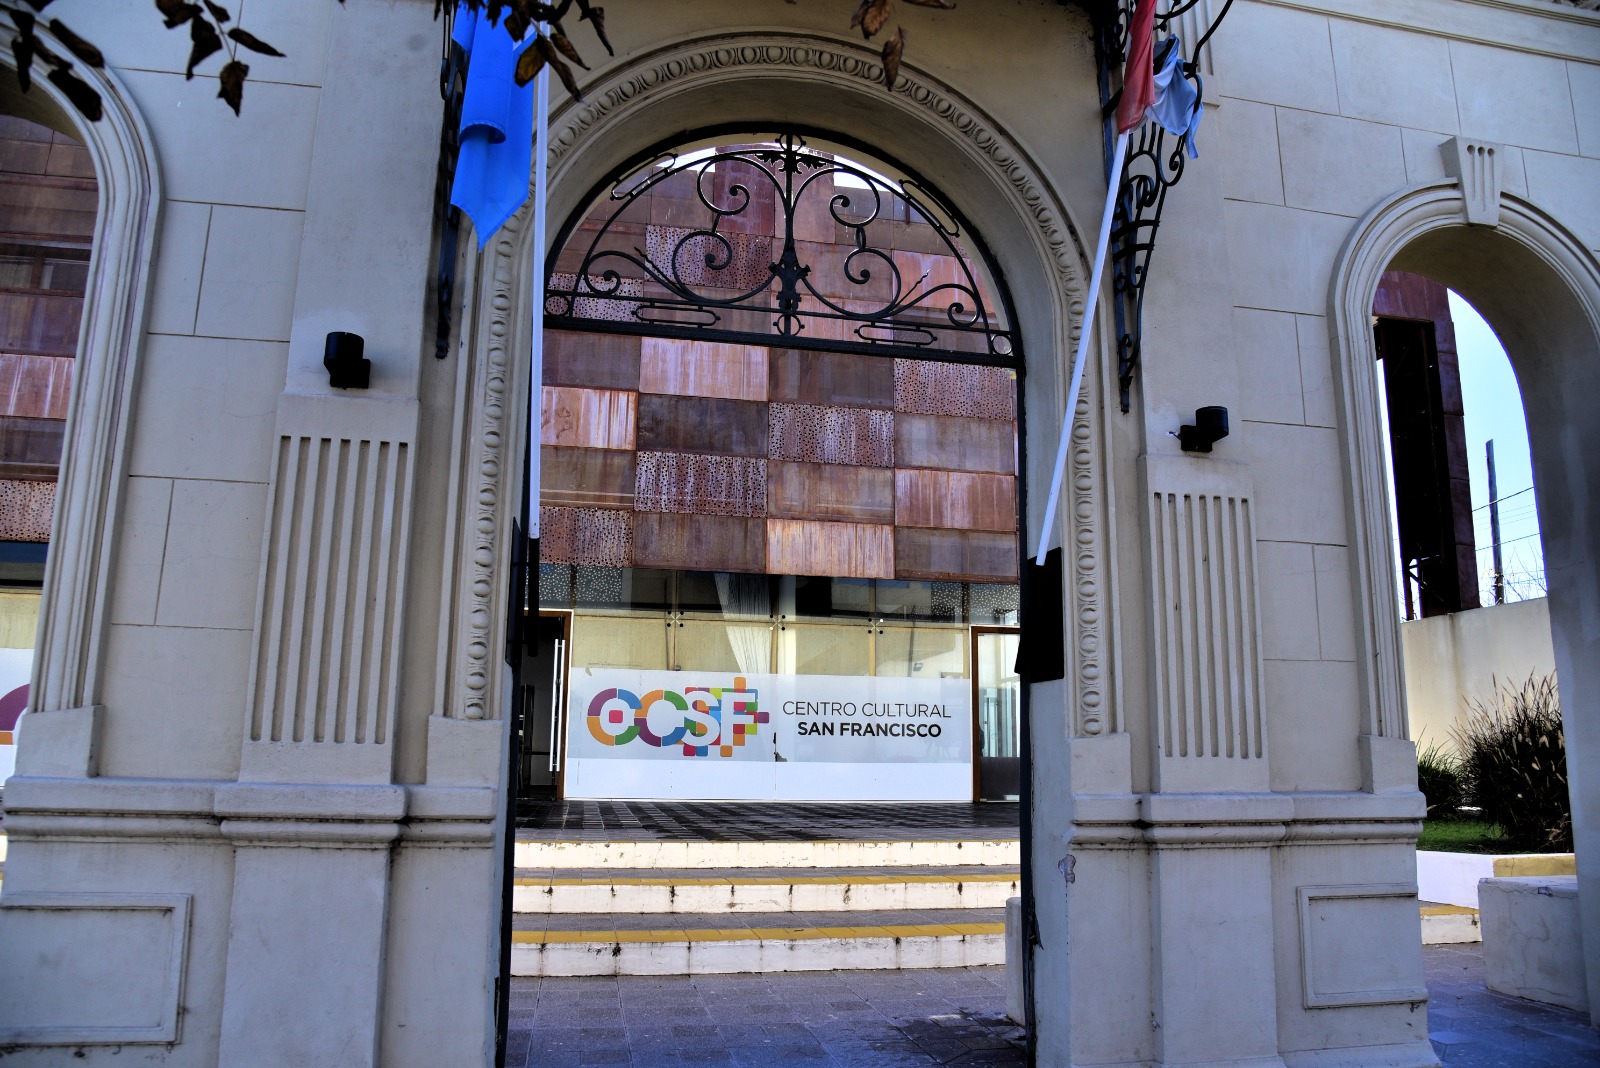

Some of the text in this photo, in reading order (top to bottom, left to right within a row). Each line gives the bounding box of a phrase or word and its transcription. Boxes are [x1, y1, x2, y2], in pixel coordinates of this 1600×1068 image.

[782, 700, 952, 718] CENTRO CULTURAL
[797, 721, 942, 738] SAN FRANCISCO
